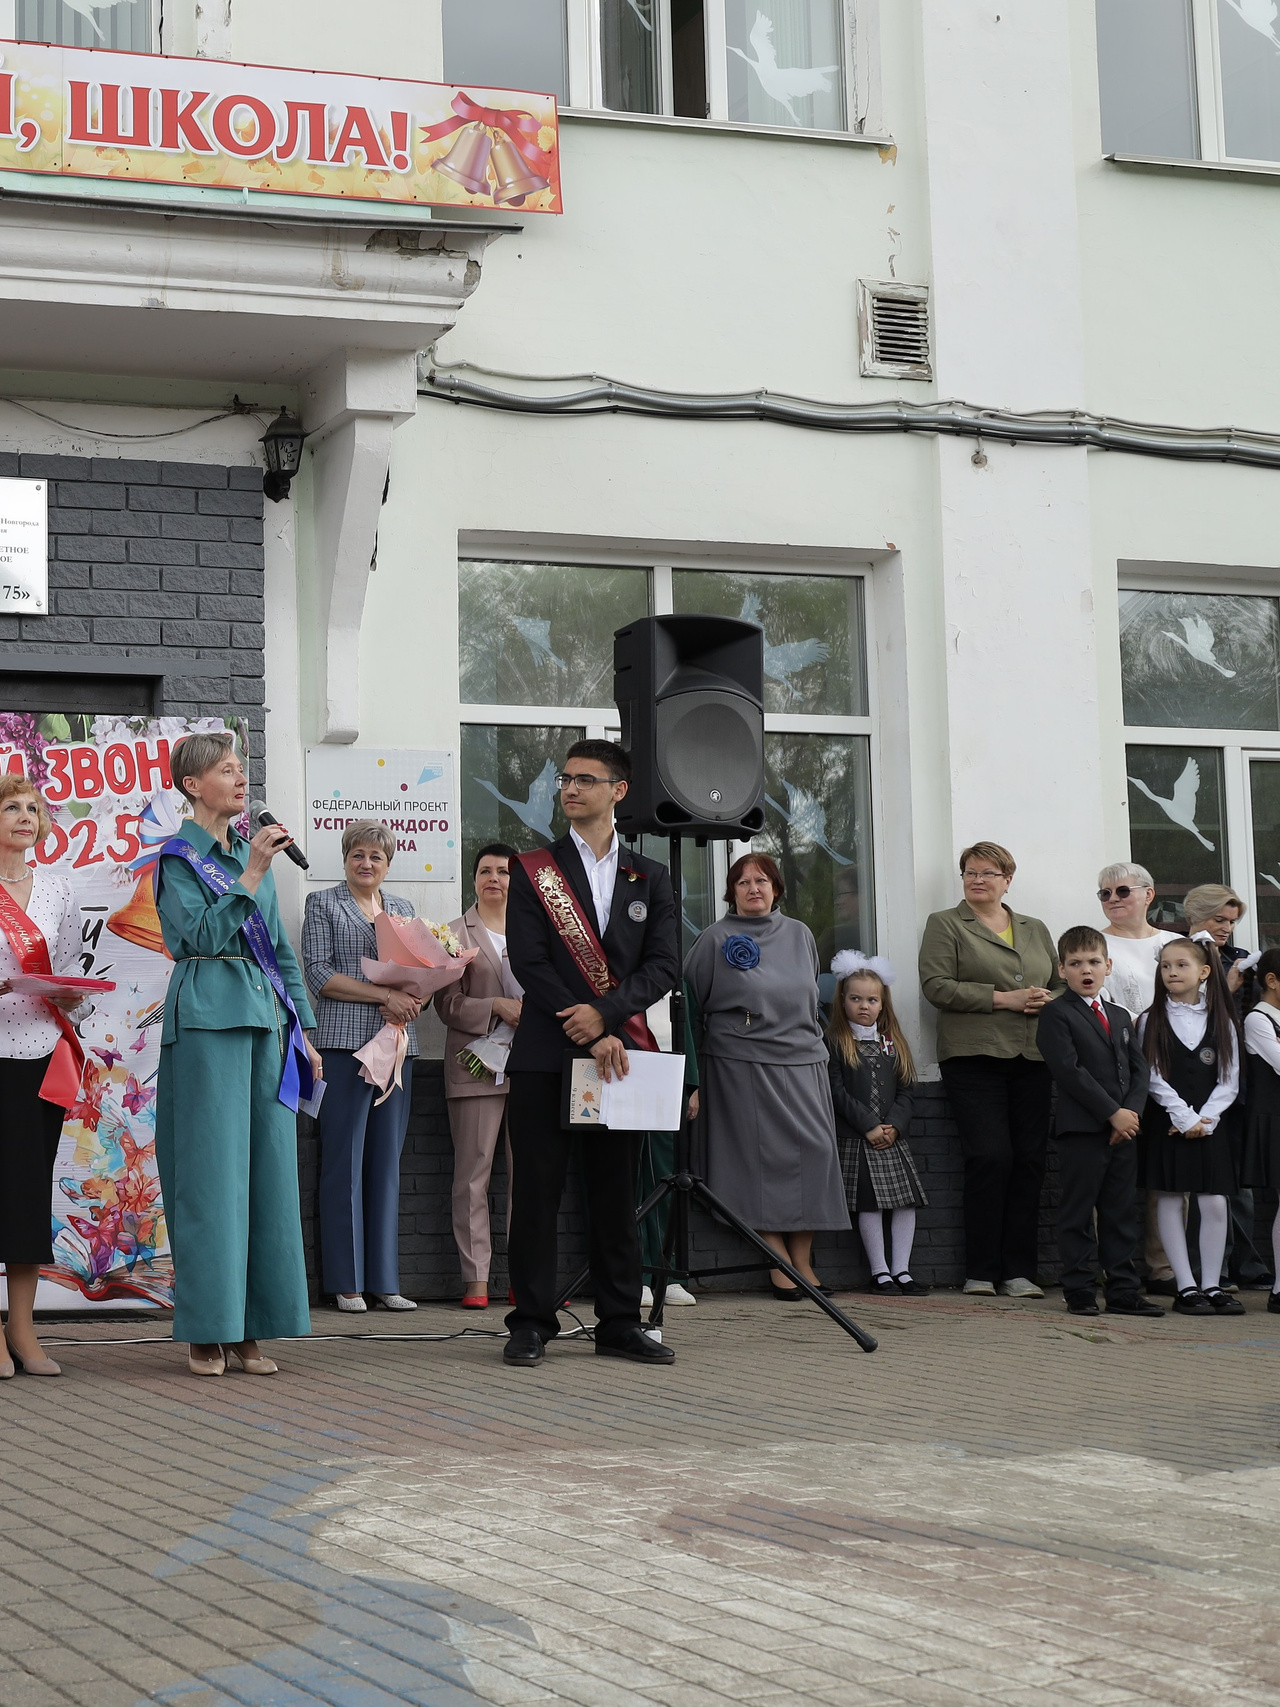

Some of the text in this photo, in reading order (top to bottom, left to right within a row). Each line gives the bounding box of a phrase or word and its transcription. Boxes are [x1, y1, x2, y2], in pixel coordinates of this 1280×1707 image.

[67, 79, 412, 171] ШКОЛА!
[0, 517, 40, 527] Новгорода
[2, 584, 31, 600] 75»
[44, 733, 233, 801] ЗВОН
[312, 799, 449, 812] ФЕДЕРАЛЬНЫЙ ПРОЕКТ
[26, 813, 144, 869] 025
[313, 817, 449, 833] УСПЕ ЖДОГО
[545, 890, 600, 970] Выпускник
